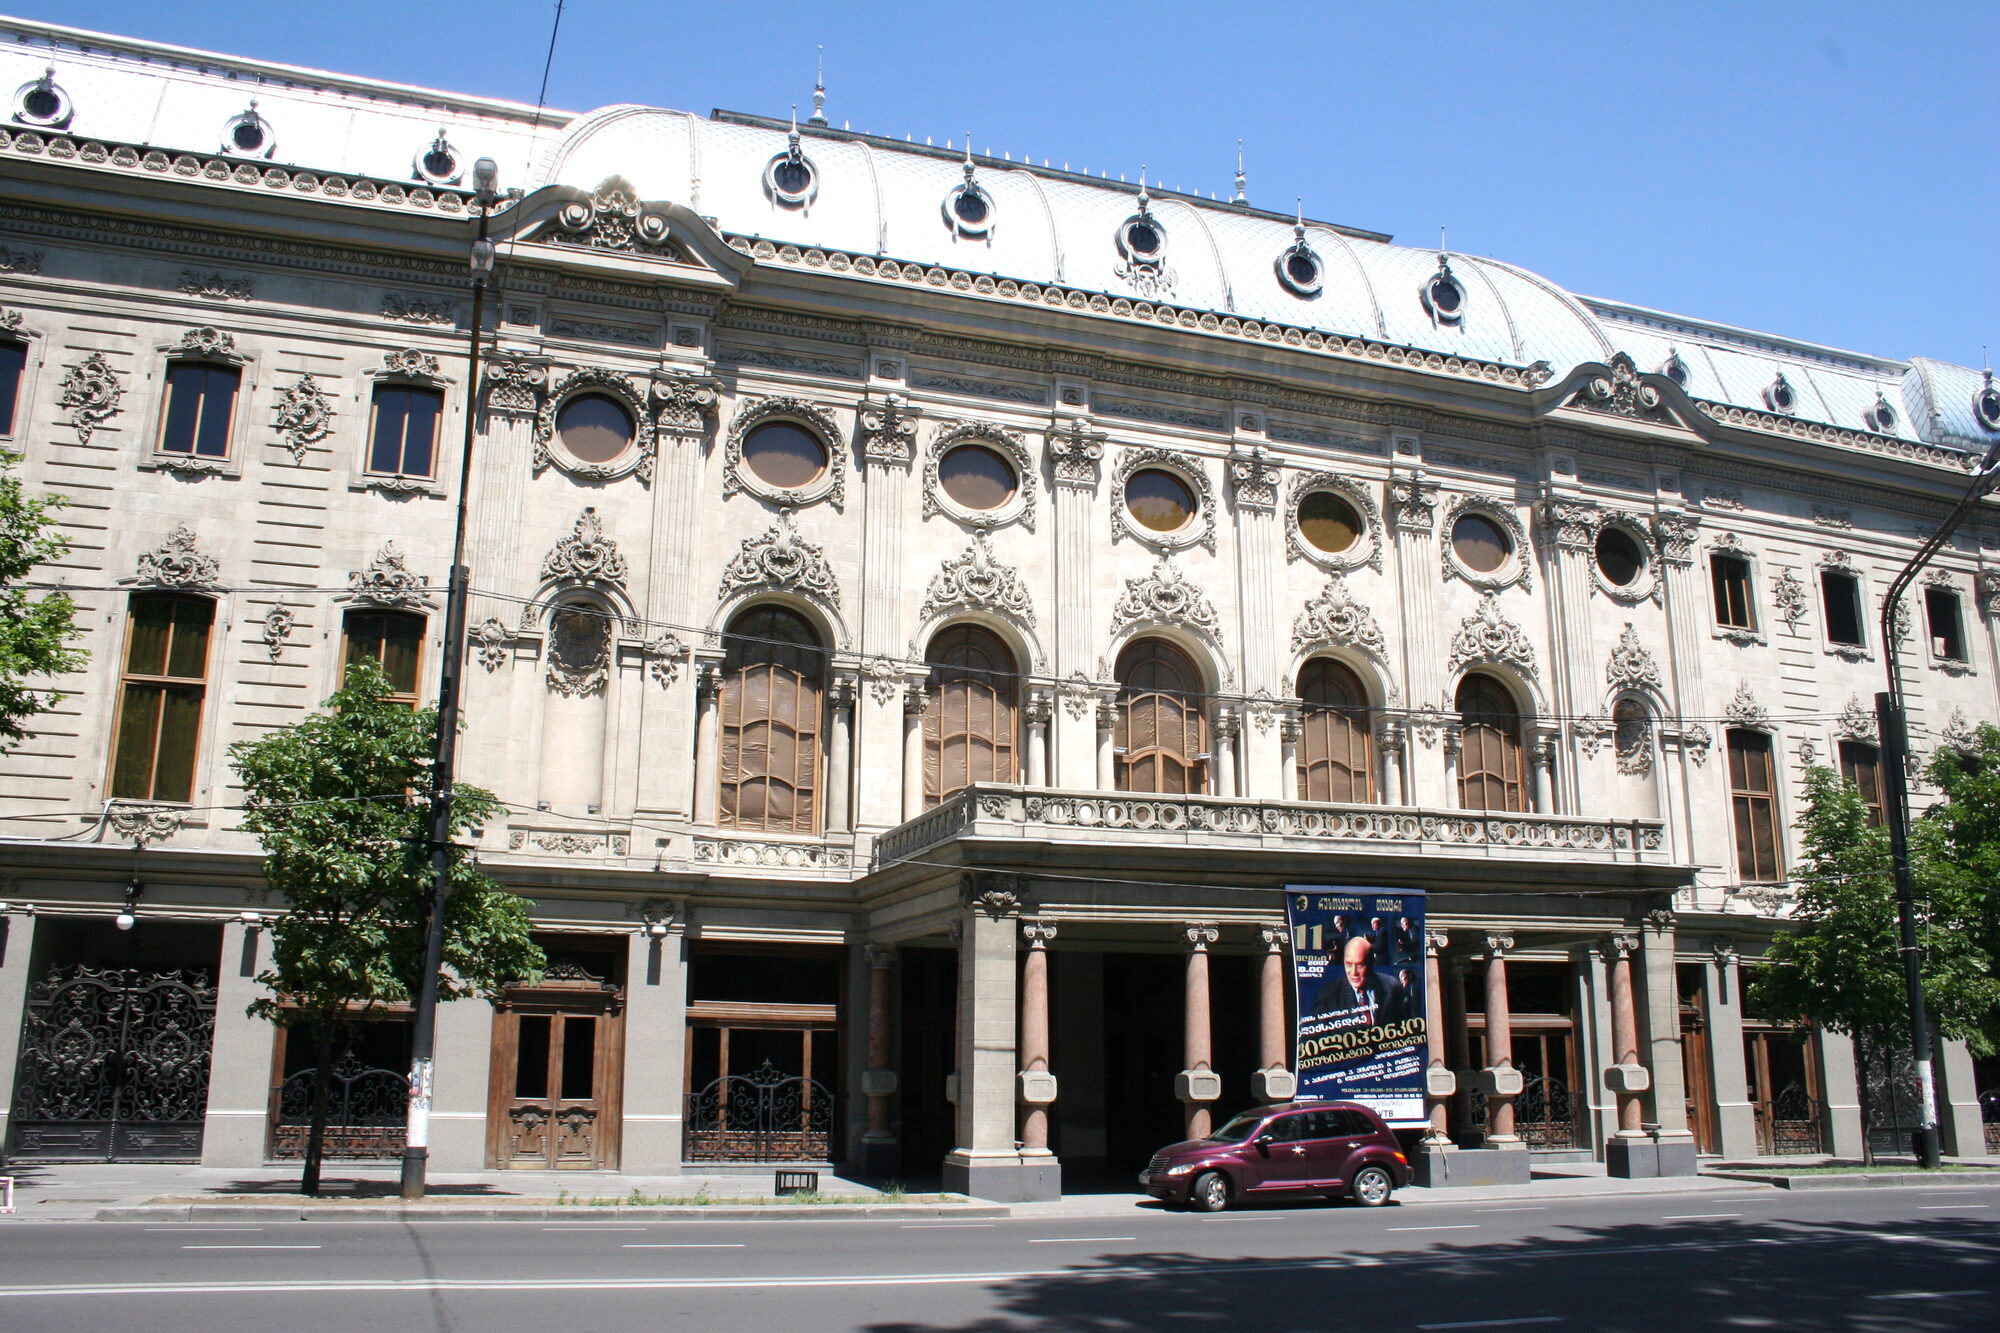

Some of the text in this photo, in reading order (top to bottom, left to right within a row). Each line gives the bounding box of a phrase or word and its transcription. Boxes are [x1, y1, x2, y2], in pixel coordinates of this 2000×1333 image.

[1294, 923, 1323, 950] 11
[1299, 1014, 1368, 1037] ლექსანდრე
[1378, 1109, 1394, 1118] VTB
